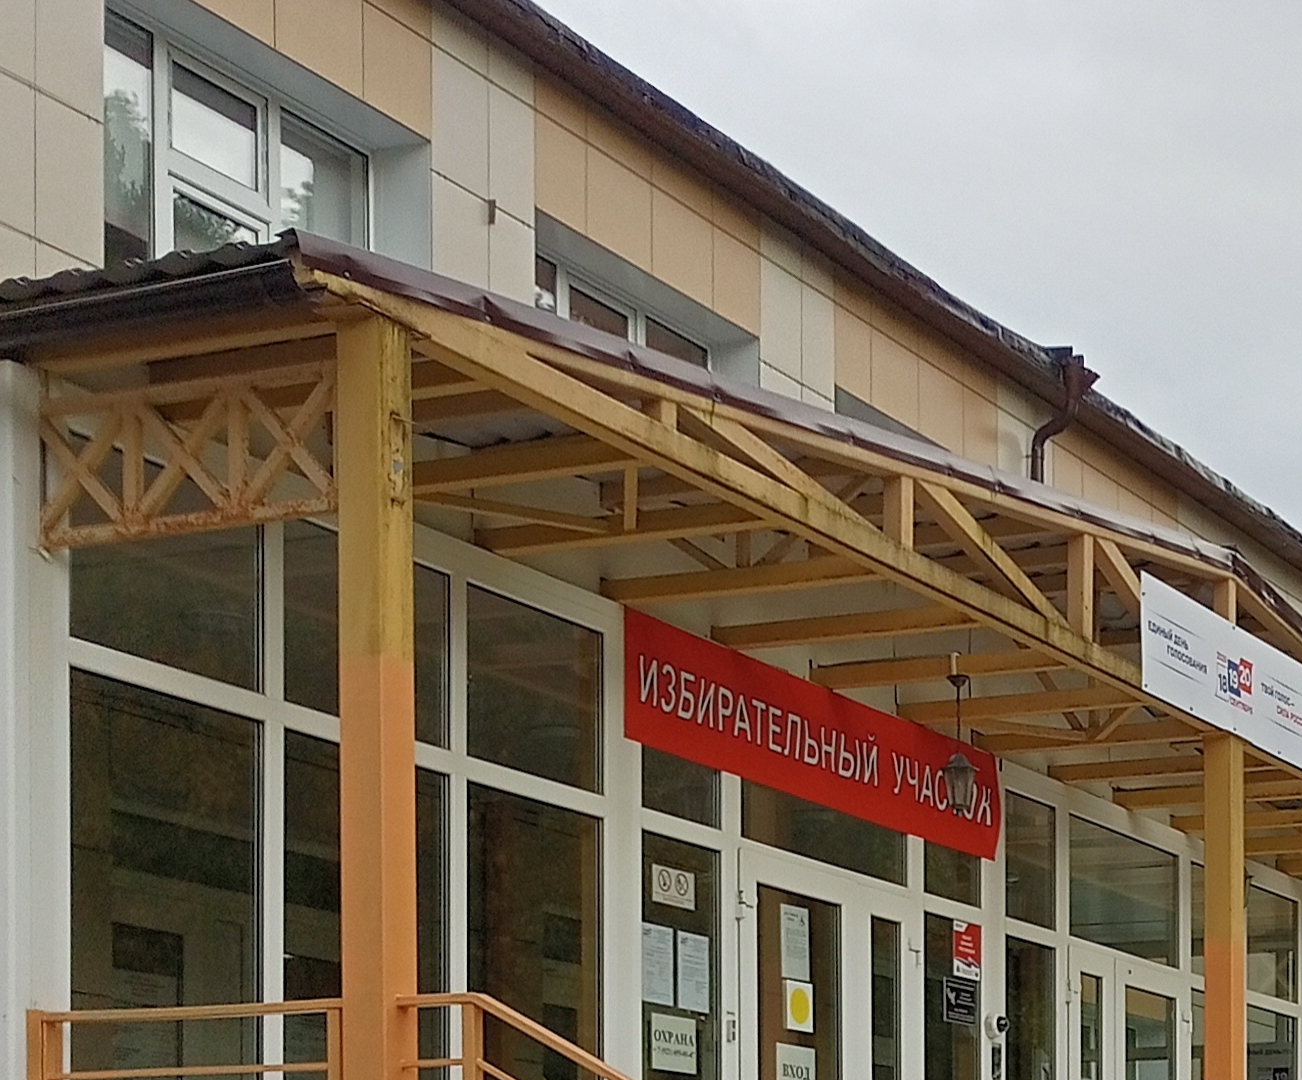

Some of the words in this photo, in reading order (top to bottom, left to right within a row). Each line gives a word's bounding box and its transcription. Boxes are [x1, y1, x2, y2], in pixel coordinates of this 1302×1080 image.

[1218, 673, 1228, 694] 18
[1228, 668, 1239, 690] 19
[1239, 665, 1251, 687] 20
[638, 654, 880, 788] ИЗБИРАТЕЛЬНЫЙ
[891, 752, 992, 826] УЧАСОК
[653, 1029, 694, 1047] ОХРАНА
